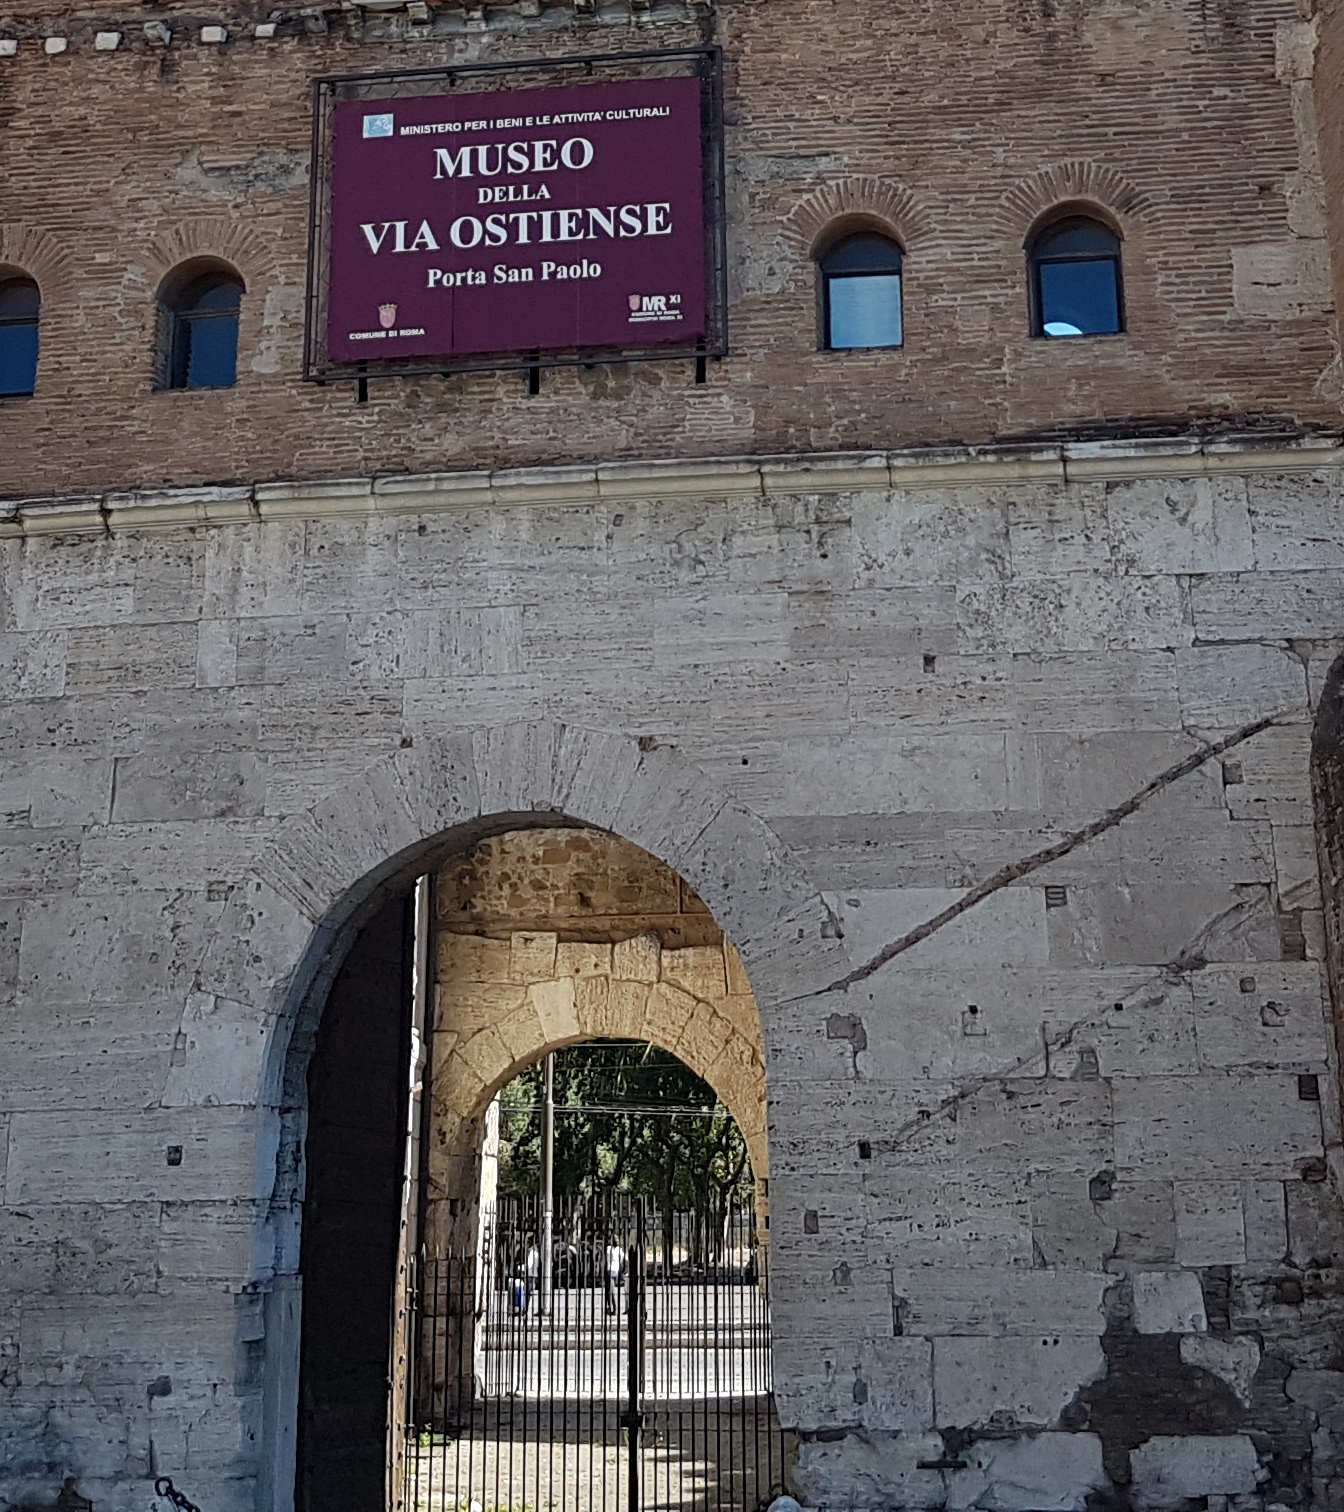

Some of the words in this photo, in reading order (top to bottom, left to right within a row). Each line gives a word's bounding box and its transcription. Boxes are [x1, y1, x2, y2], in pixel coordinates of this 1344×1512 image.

[399, 122, 462, 136] MINISTERO
[464, 120, 487, 131] PER
[489, 119, 494, 129] I
[495, 117, 523, 129] BENI
[525, 116, 533, 126] E
[535, 115, 551, 125] LE
[552, 111, 604, 124] ATTIVITA'
[605, 106, 670, 120] CULTURALI
[432, 136, 595, 180] MUSEO
[477, 183, 551, 204] DELLA
[359, 218, 441, 256] VIA
[449, 202, 673, 249] OSTIENSE
[426, 267, 487, 288] Porta
[493, 263, 534, 284] San
[541, 258, 602, 280] Paolo
[642, 295, 667, 311] MR
[669, 294, 681, 304] XI
[348, 330, 386, 340] COMUNE
[399, 328, 425, 336] ROMA
